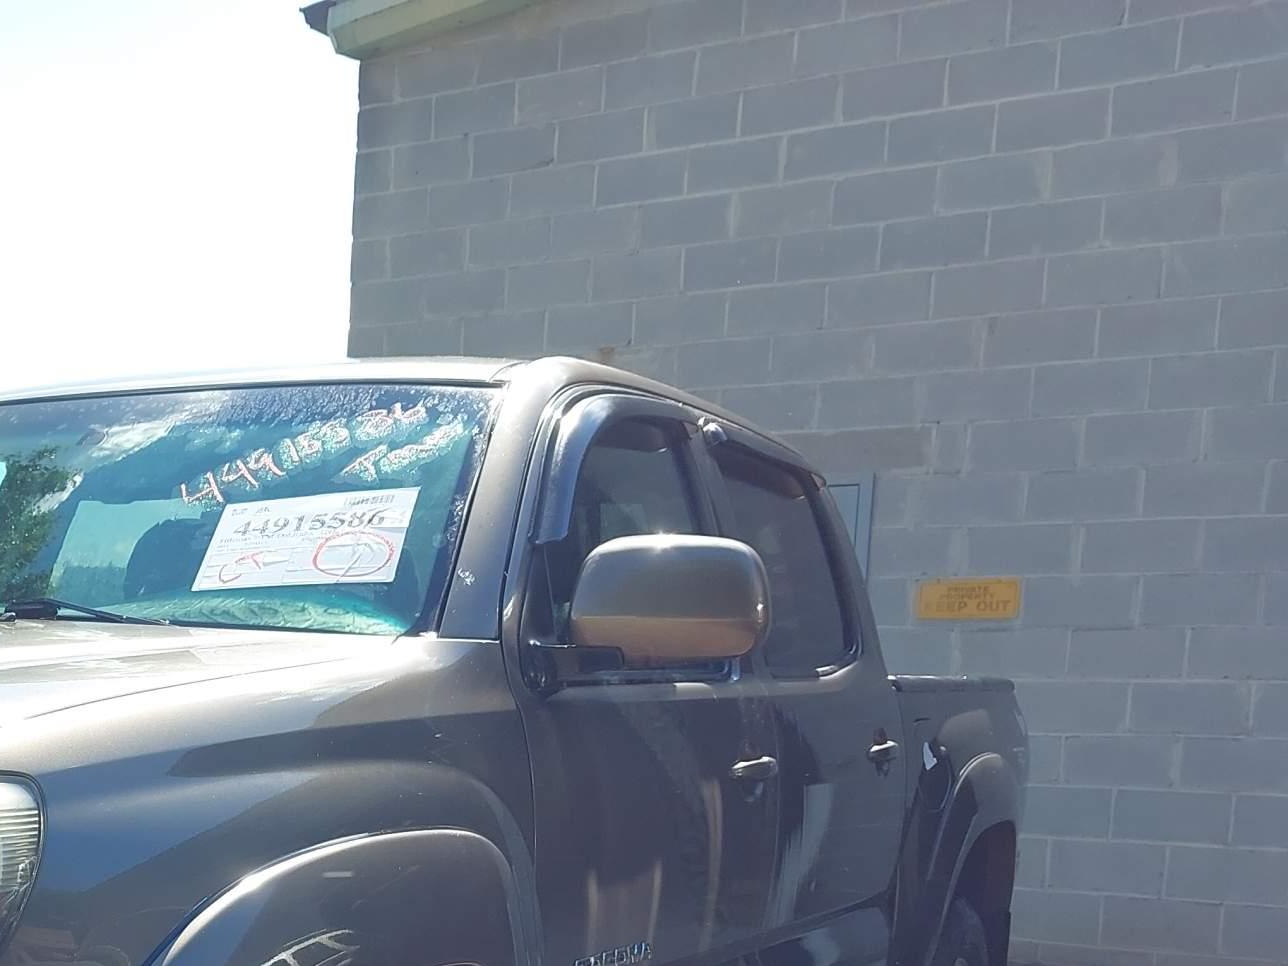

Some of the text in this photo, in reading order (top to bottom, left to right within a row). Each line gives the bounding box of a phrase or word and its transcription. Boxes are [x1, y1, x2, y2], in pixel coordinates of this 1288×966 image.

[233, 508, 388, 537] 44915586
[924, 599, 1011, 613] EEP OUT
